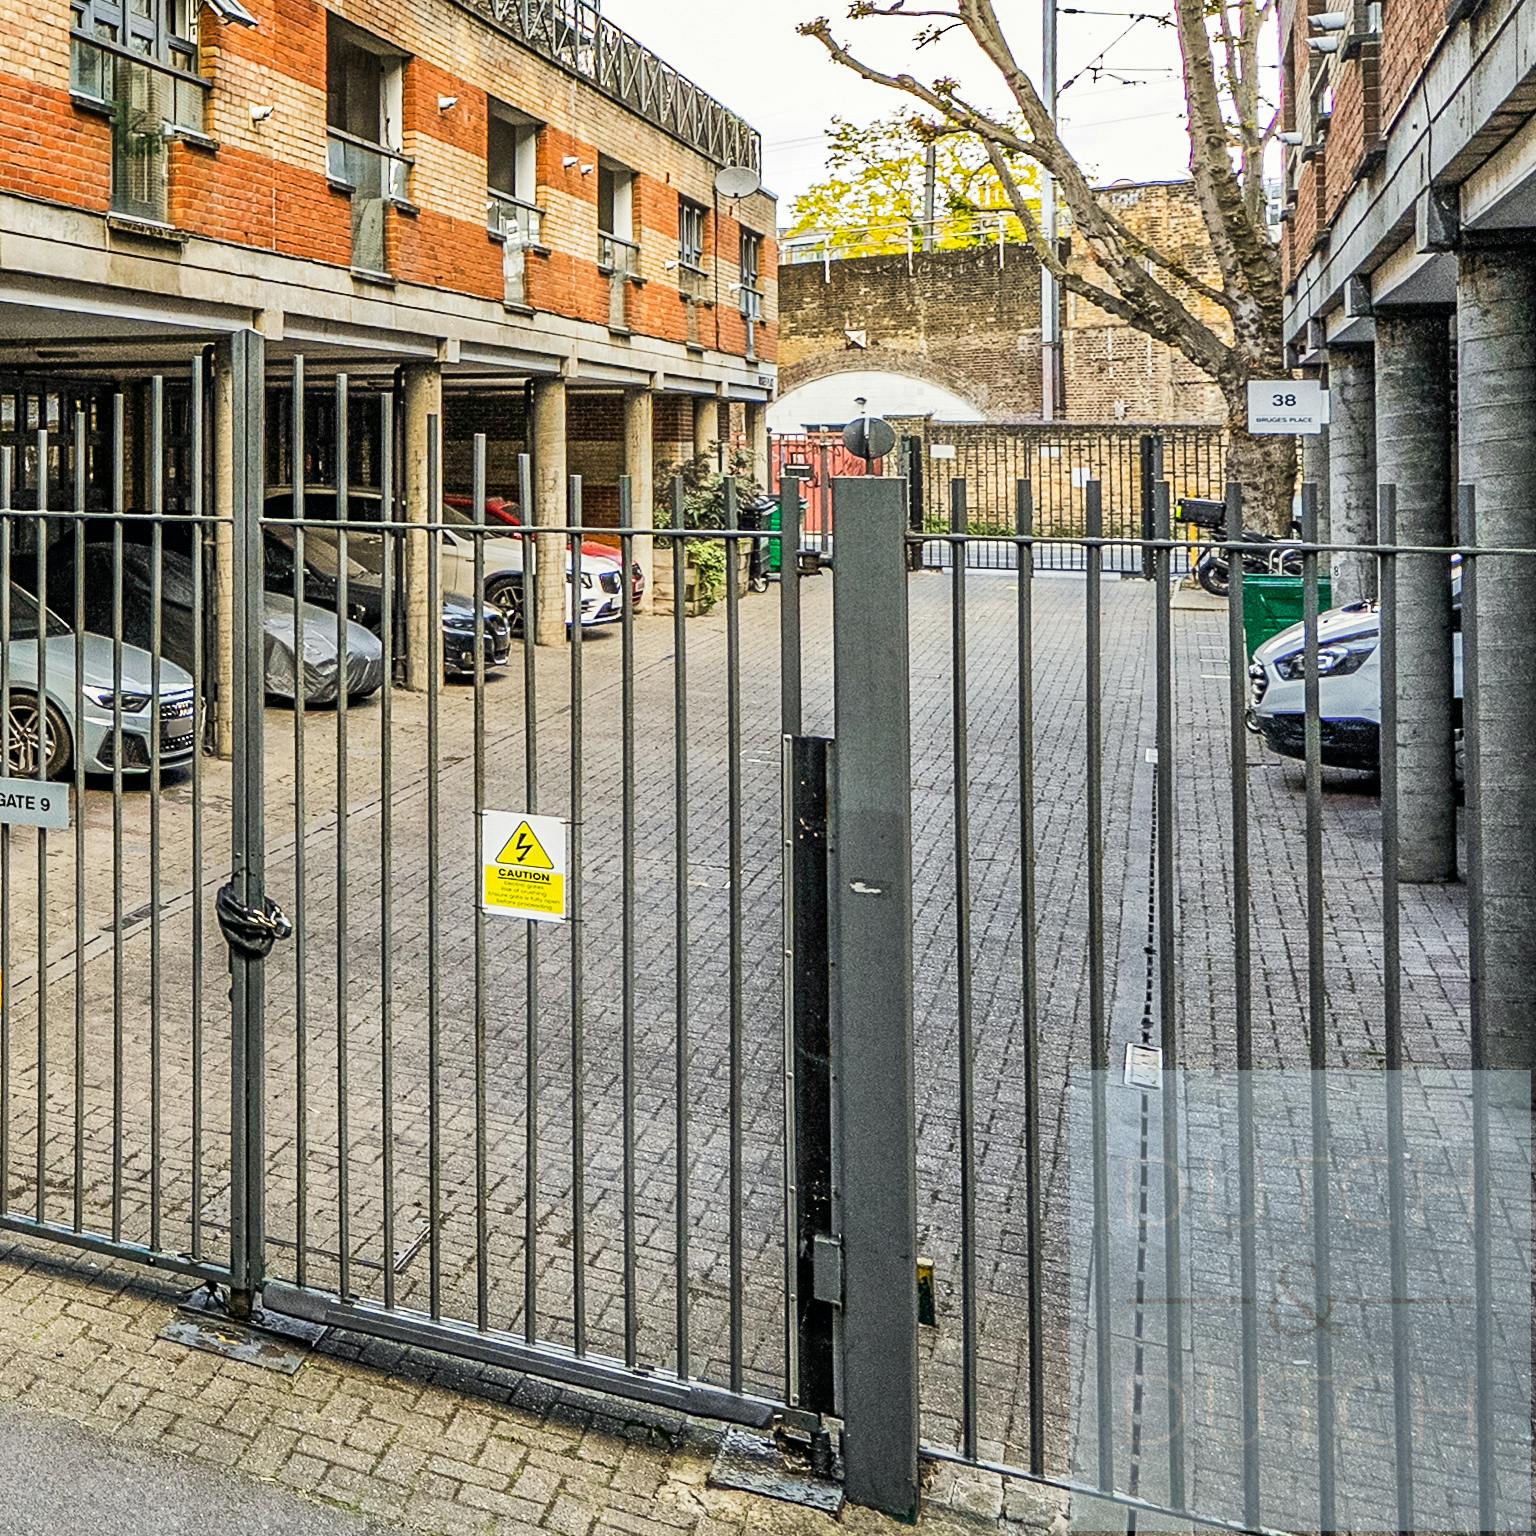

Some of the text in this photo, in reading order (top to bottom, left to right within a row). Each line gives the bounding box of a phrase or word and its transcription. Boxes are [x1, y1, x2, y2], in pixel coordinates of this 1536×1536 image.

[1272, 394, 1296, 407] 38
[40, 798, 50, 811] 9
[499, 868, 550, 881] CAUTION
